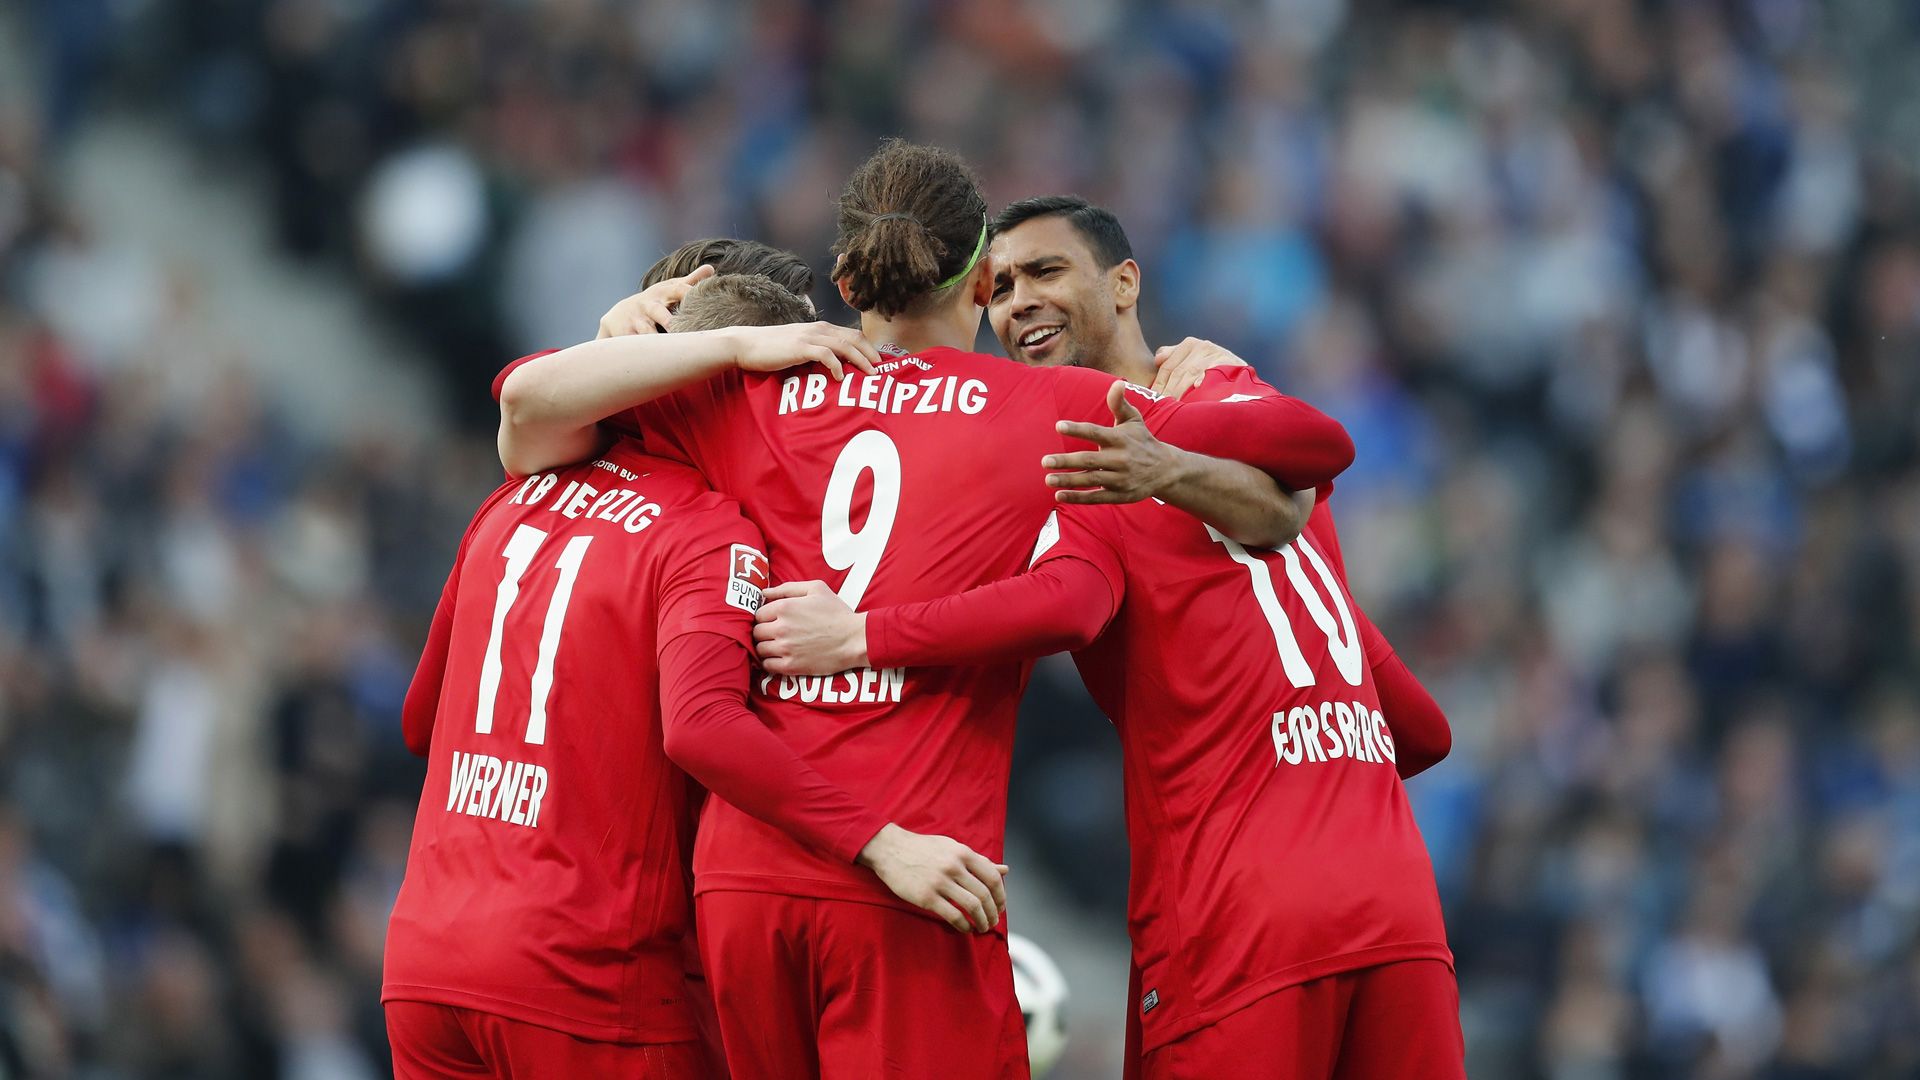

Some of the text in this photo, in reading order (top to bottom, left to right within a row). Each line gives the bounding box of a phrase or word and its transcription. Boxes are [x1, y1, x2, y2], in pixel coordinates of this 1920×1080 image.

[778, 372, 988, 415] RB LEIPZIG
[821, 429, 902, 613] 9
[475, 524, 595, 746] 11
[1202, 521, 1364, 688] 10
[446, 751, 548, 828] WERNER
[1271, 700, 1396, 768] FORSBERG
